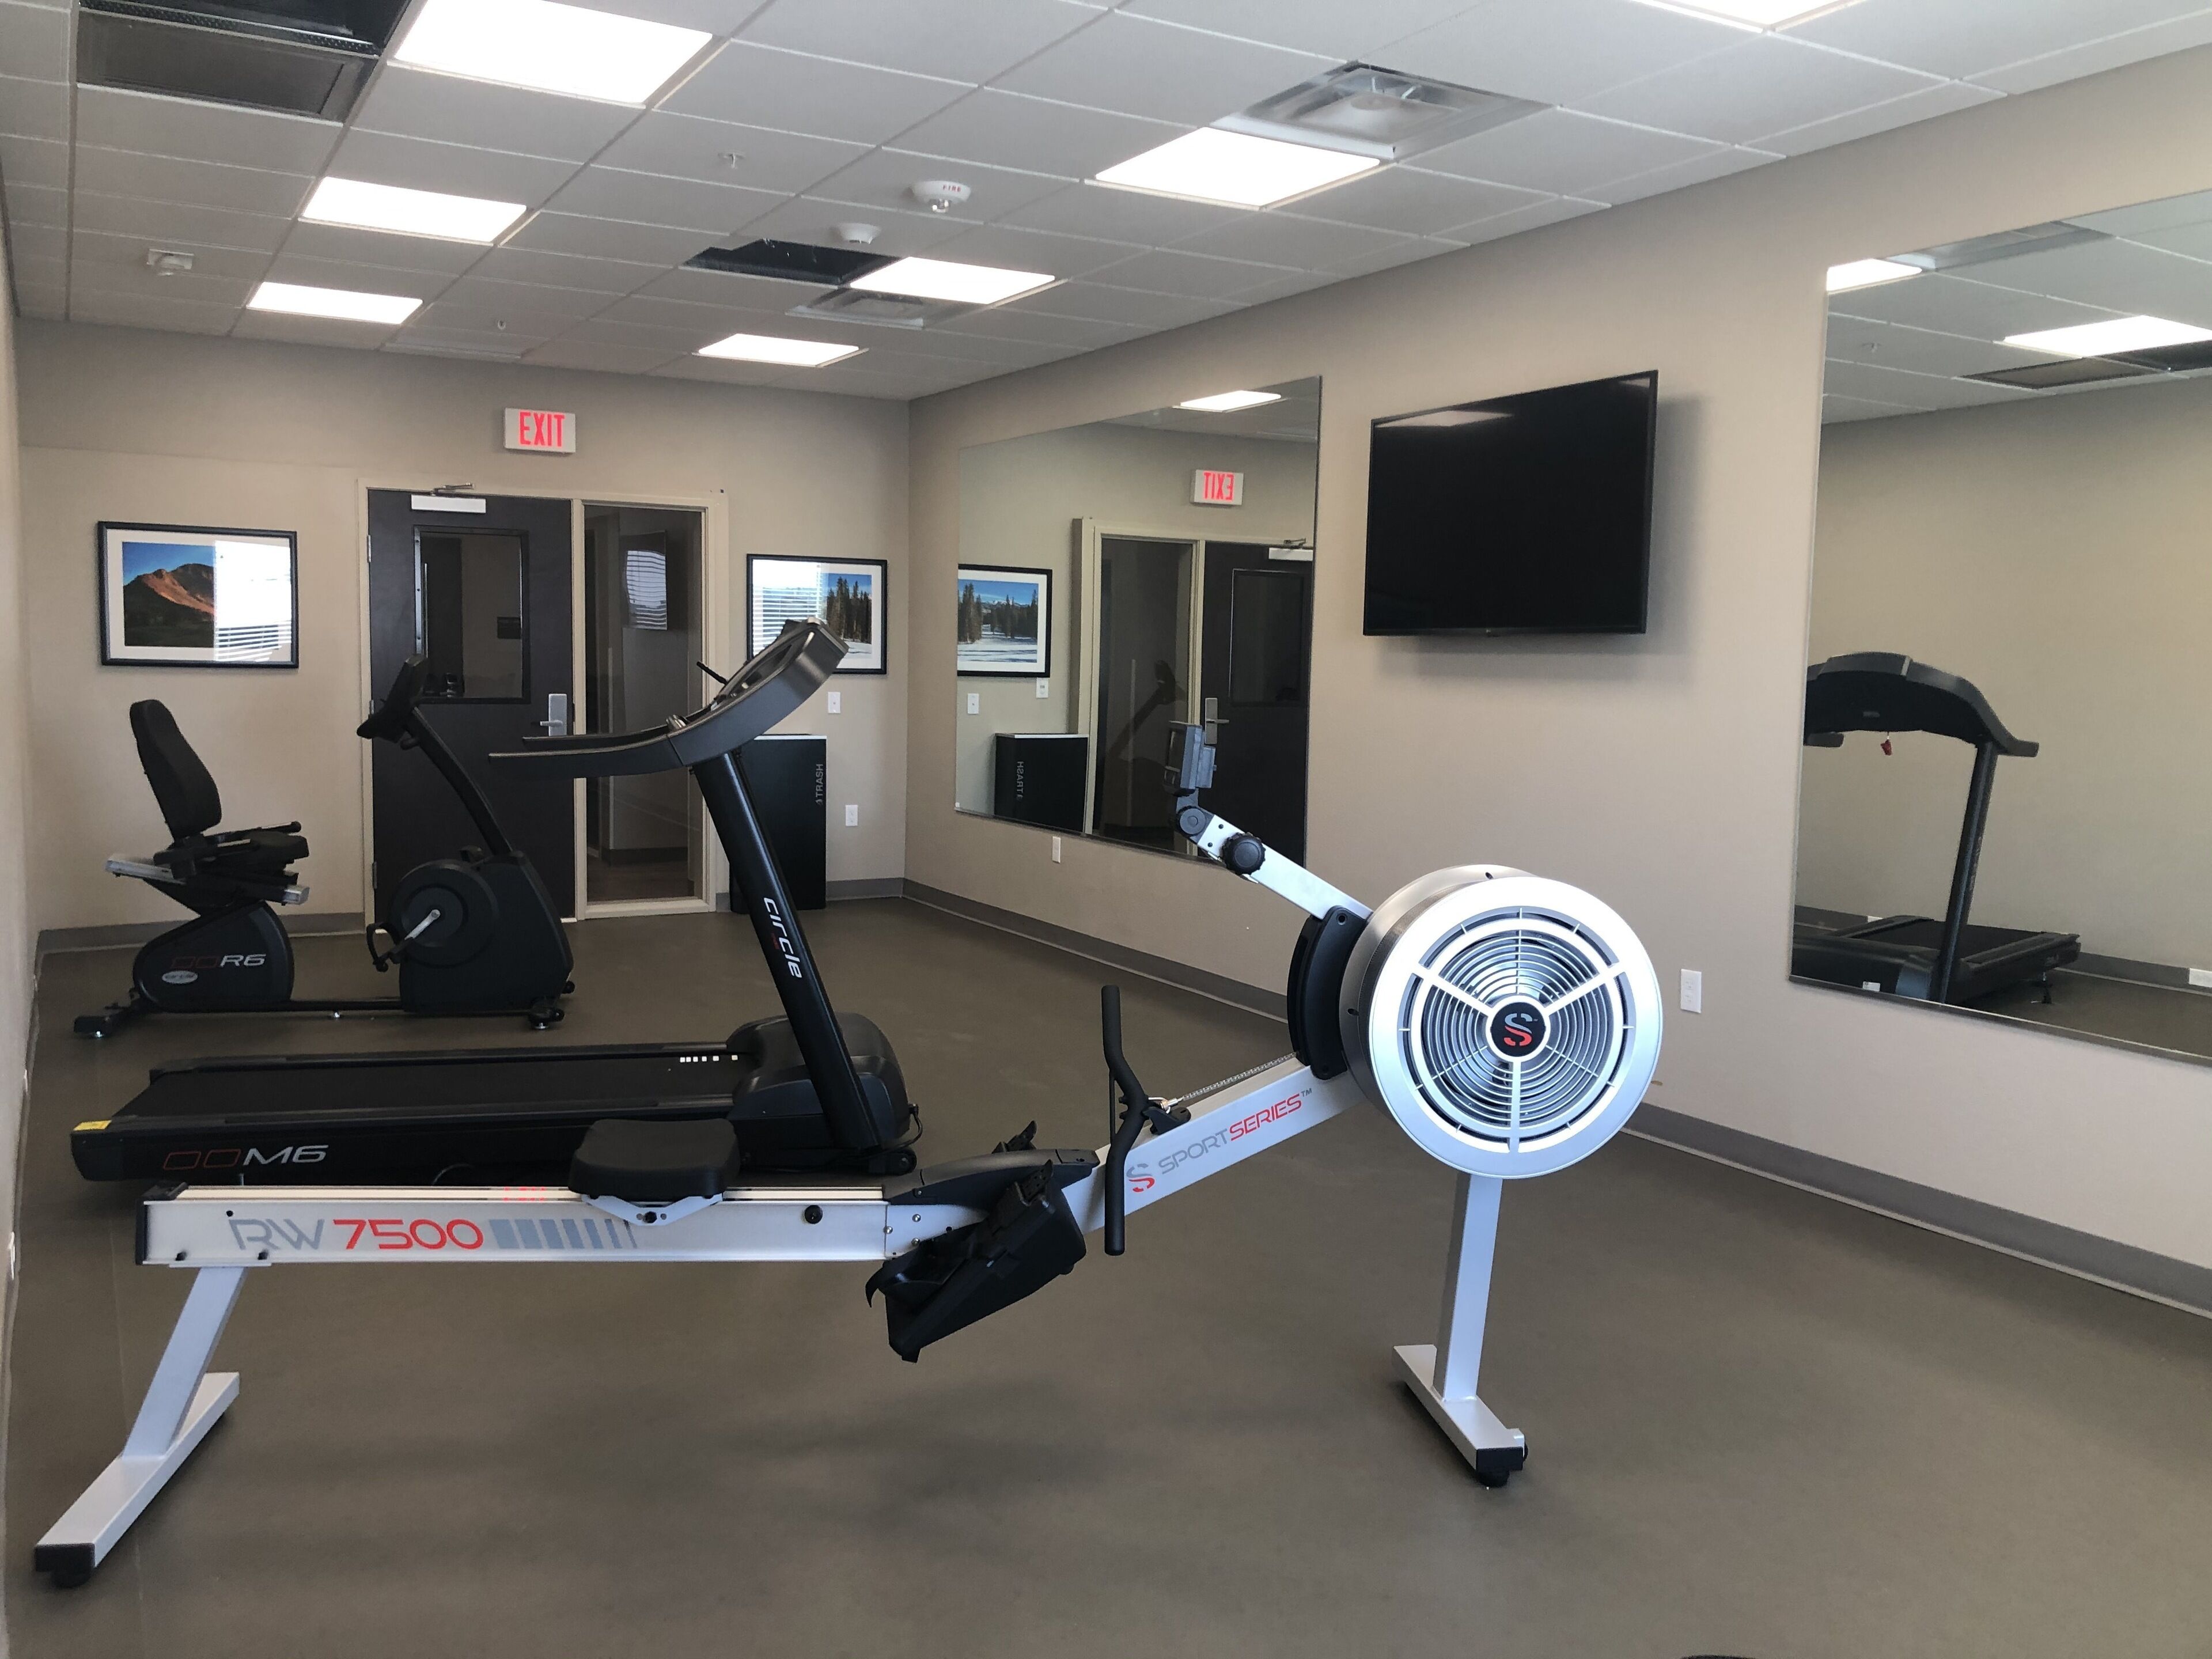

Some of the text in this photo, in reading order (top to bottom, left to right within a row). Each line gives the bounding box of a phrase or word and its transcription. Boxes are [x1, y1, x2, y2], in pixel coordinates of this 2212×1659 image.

[942, 184, 961, 192] FIRE
[520, 411, 565, 447] EXIT
[815, 763, 824, 798] TRASH
